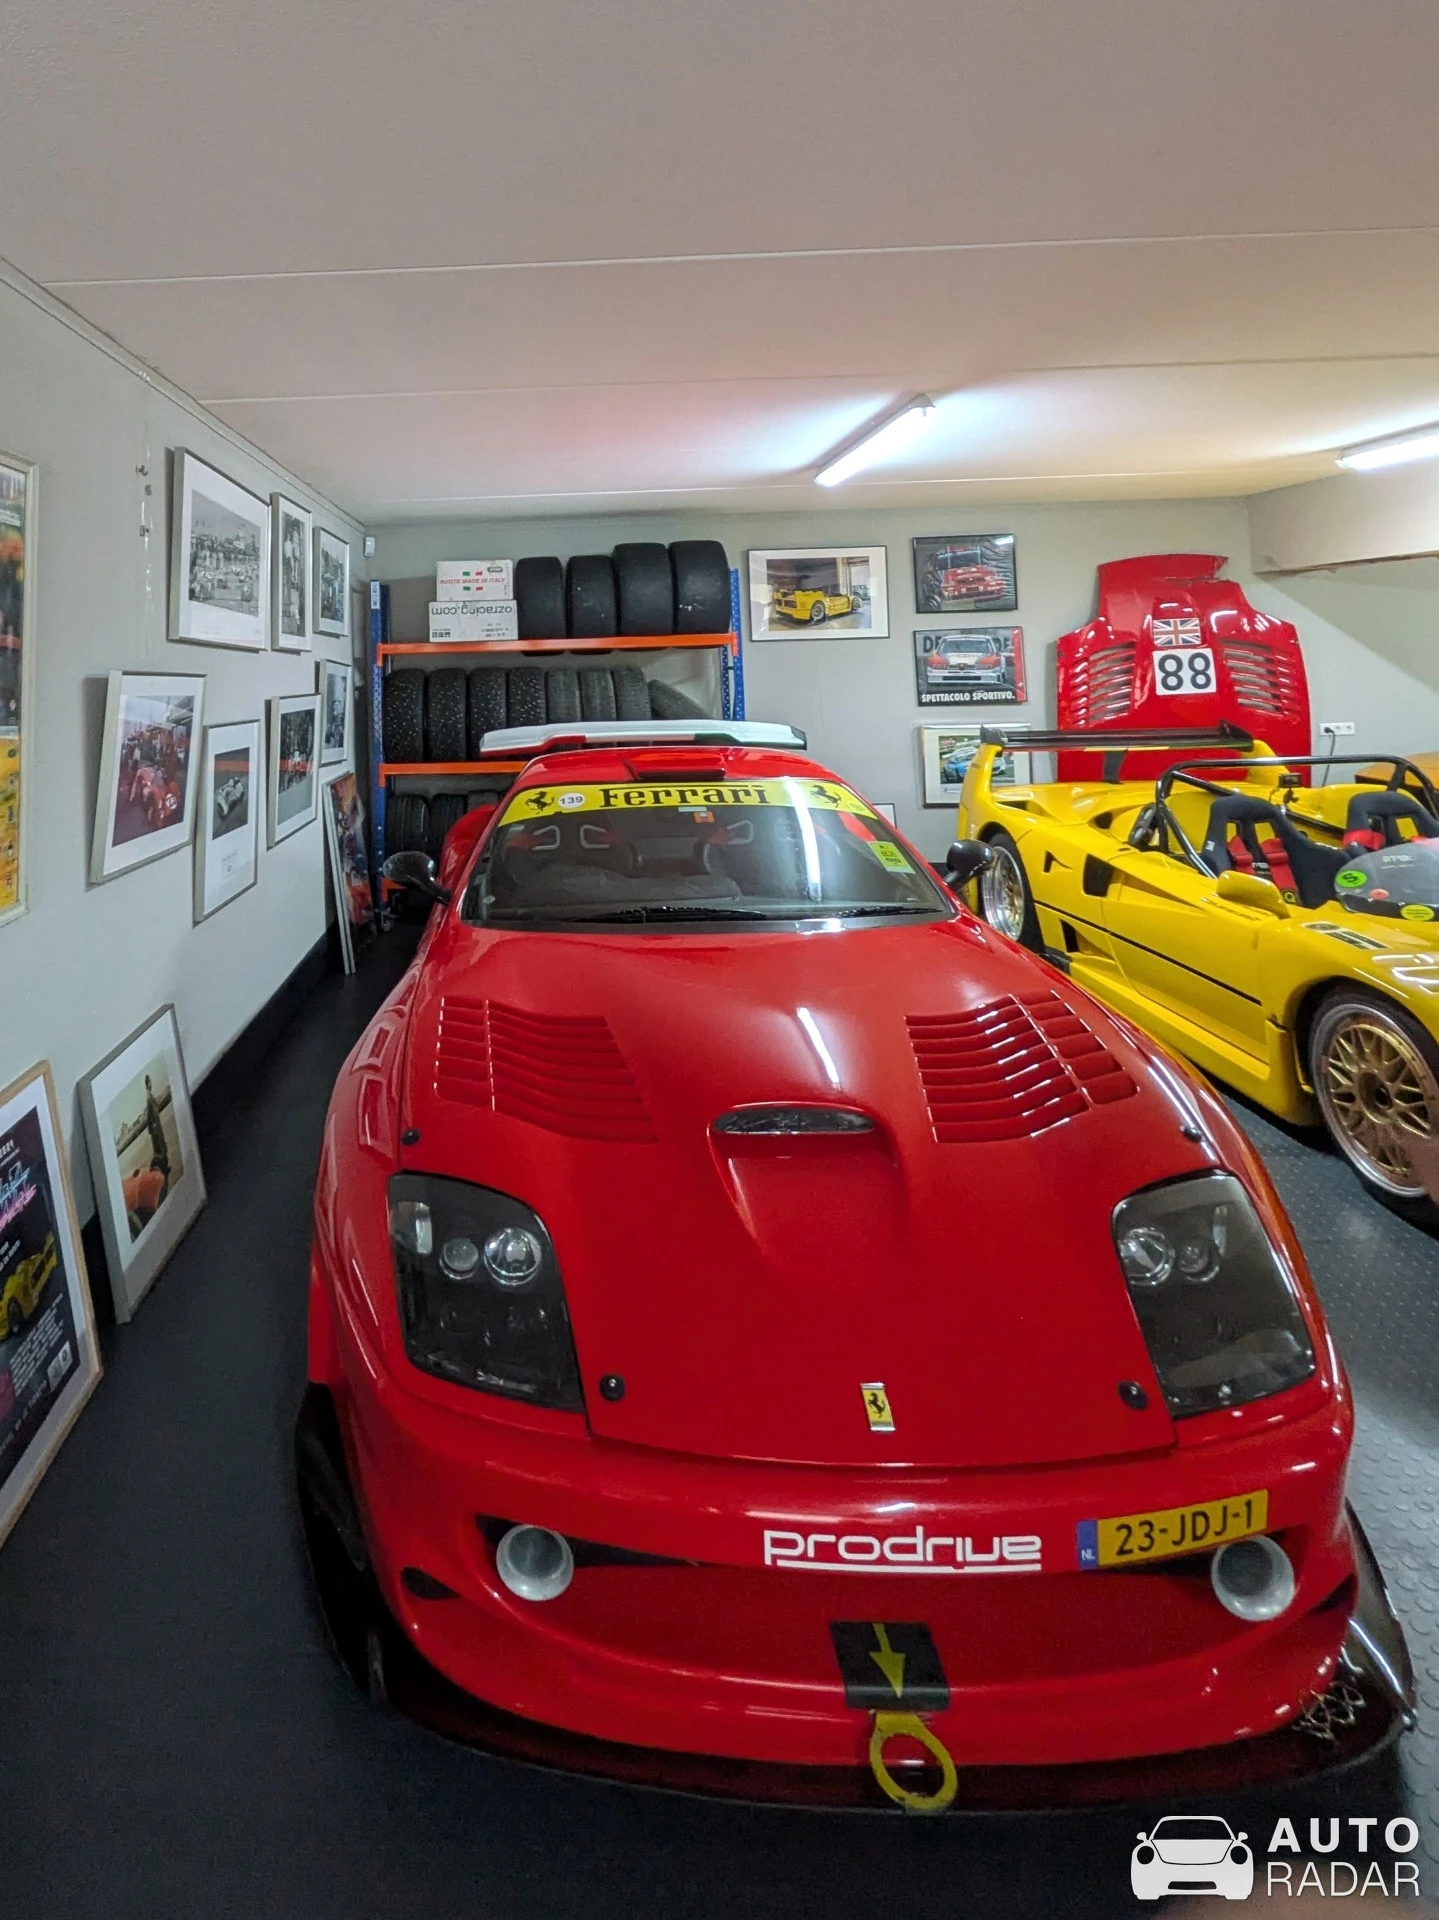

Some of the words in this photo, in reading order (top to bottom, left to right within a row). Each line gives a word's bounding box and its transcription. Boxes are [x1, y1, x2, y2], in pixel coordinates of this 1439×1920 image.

[431, 604, 513, 617] ozracing.com
[1158, 652, 1212, 691] 88
[921, 693, 971, 703] SPETTACOLO
[972, 691, 1016, 701] SPORTIVO.
[559, 795, 584, 805] 139
[599, 785, 771, 808] Ferrari
[1115, 1498, 1253, 1557] 23-JDJ-1
[763, 1525, 1042, 1573] prodrive
[1081, 1548, 1096, 1561] NL
